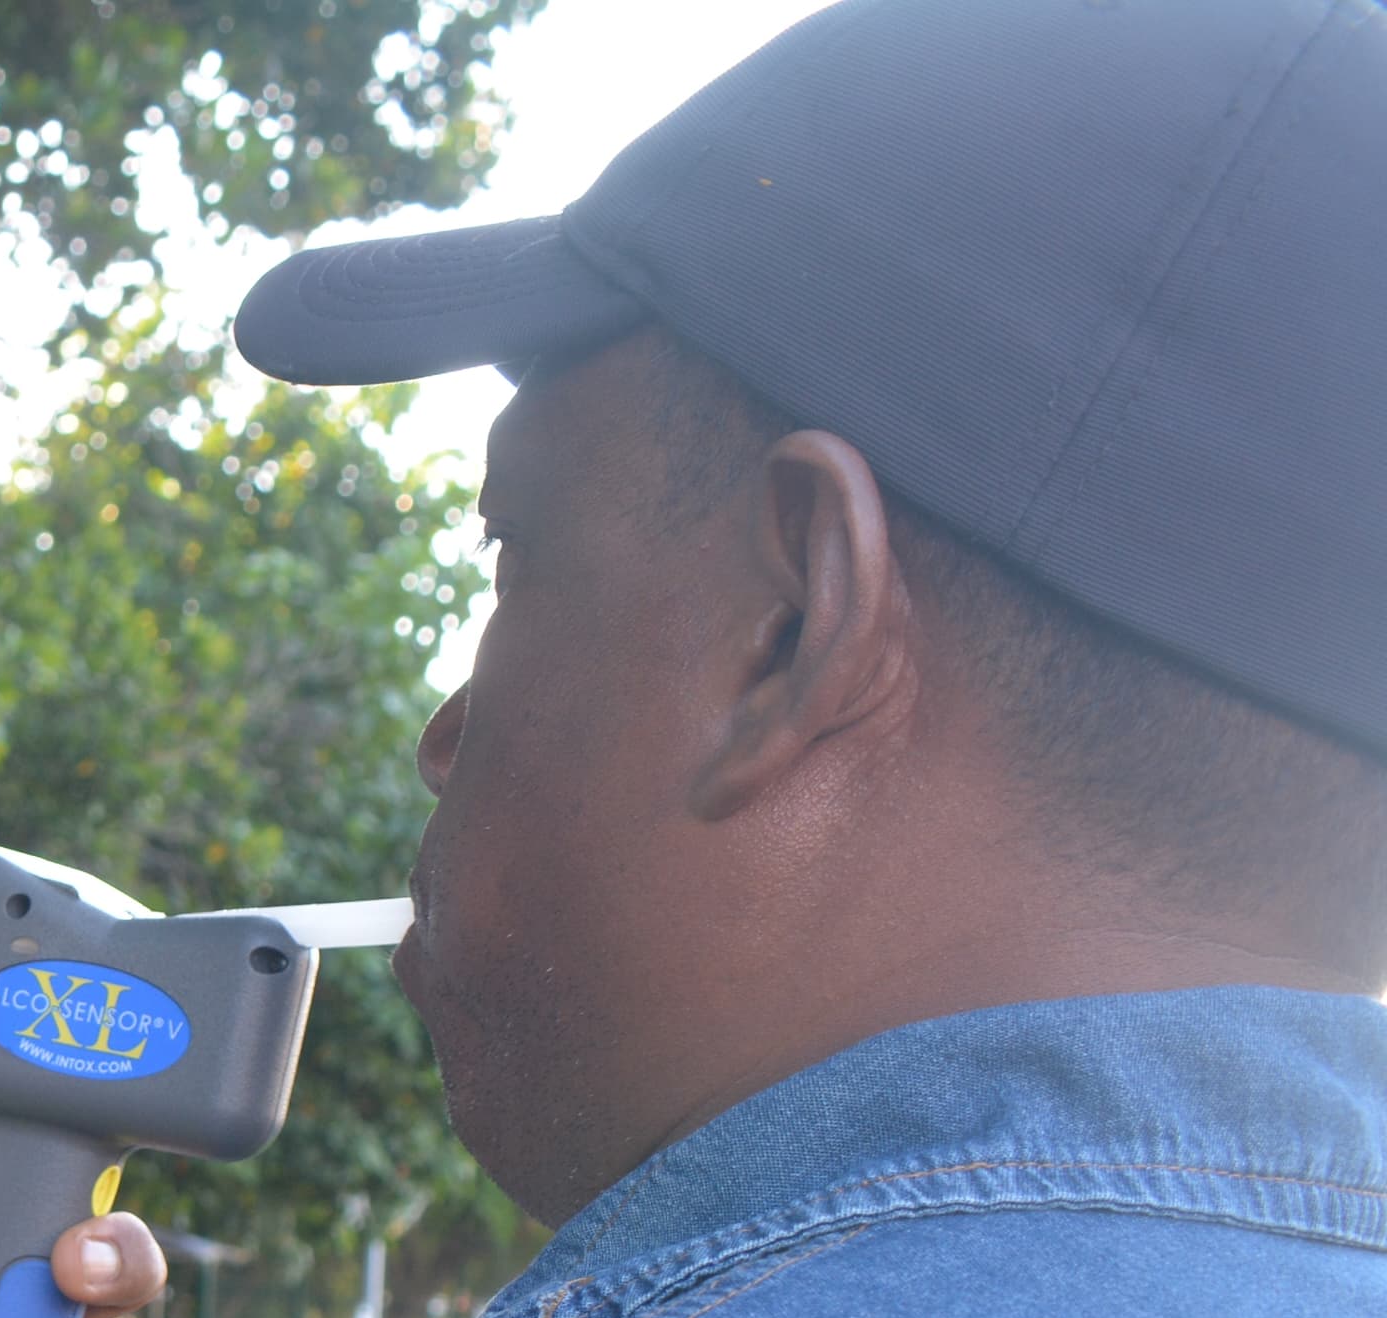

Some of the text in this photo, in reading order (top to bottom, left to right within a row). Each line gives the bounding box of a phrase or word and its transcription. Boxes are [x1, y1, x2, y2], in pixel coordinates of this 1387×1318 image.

[14, 967, 148, 1060] XL
[168, 1018, 184, 1041] V
[18, 1037, 133, 1074] WWW.INTOX.COM
